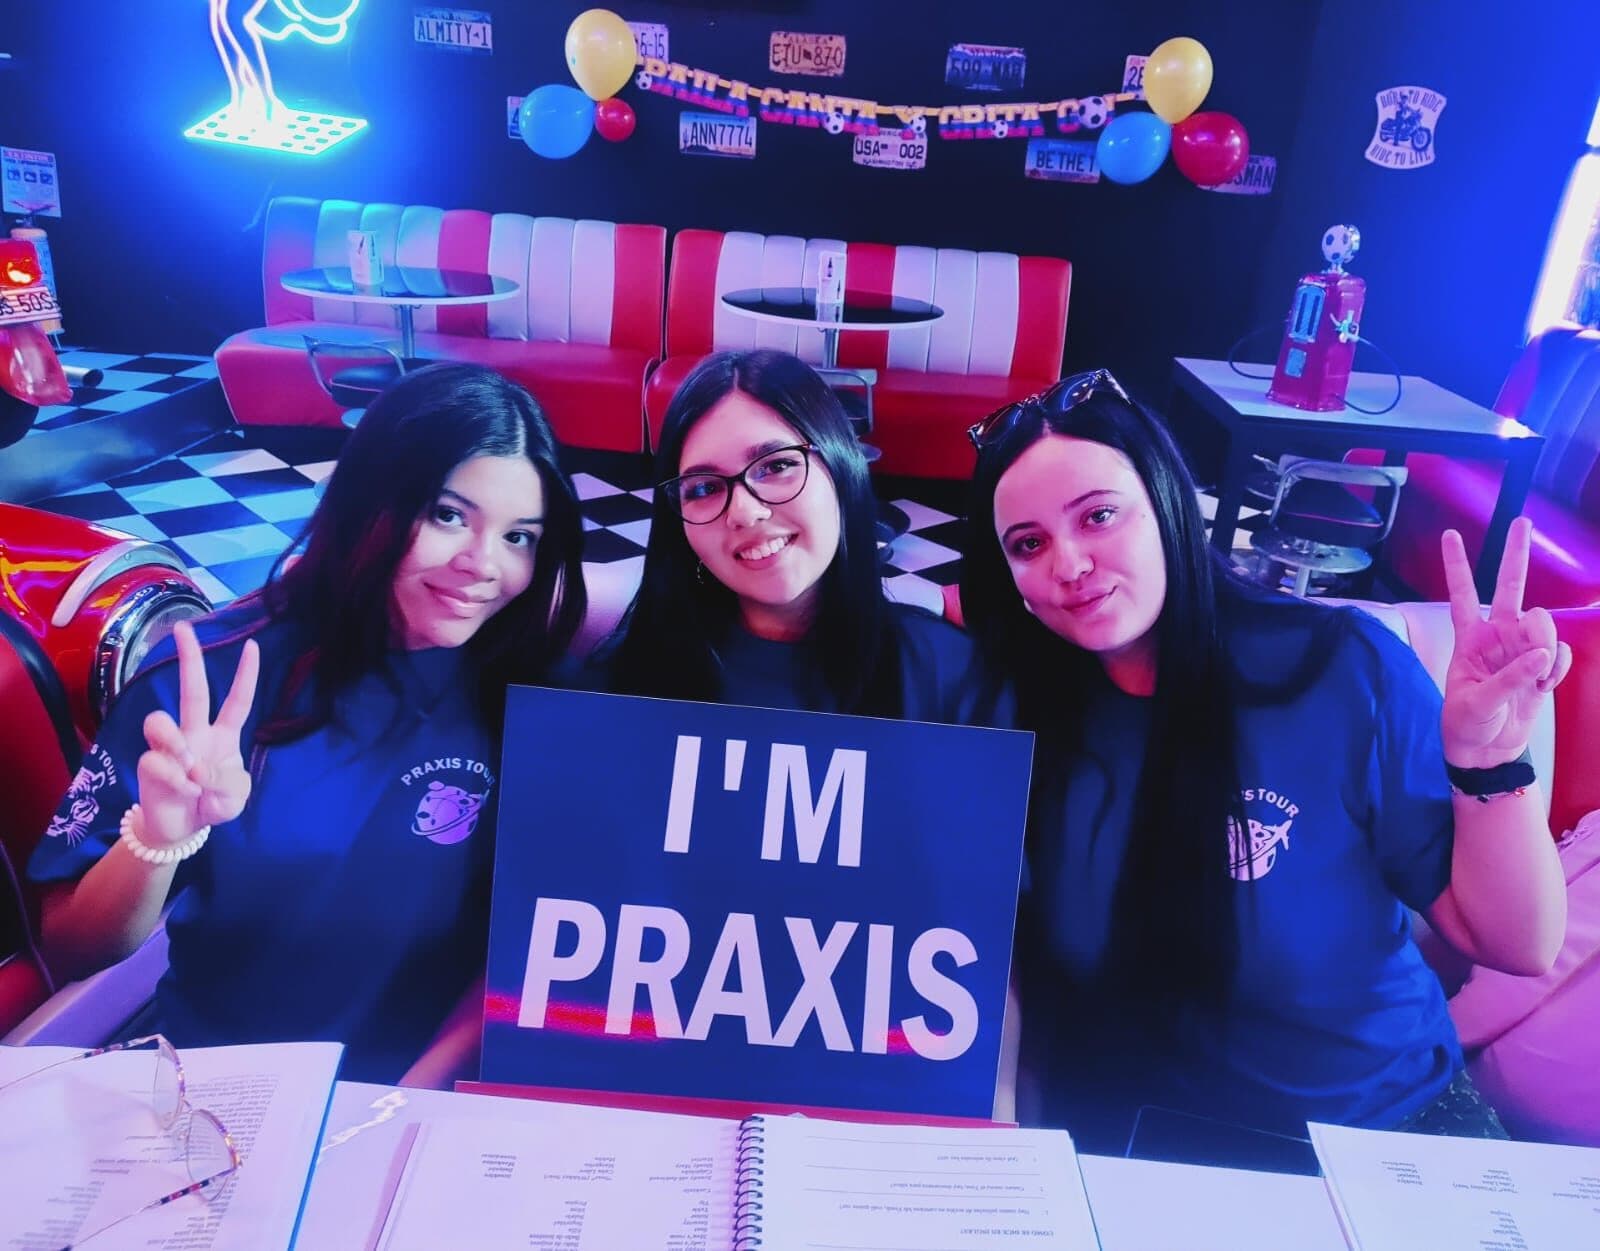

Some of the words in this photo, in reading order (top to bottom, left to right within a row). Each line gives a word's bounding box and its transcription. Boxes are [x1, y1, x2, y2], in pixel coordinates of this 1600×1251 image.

[900, 144, 924, 159] 002
[98, 749, 117, 786] TOUR
[401, 757, 462, 786] PRAXIS
[664, 735, 867, 867] I'M
[1257, 788, 1300, 818] TOUR
[517, 896, 979, 1061] PRAXIS
